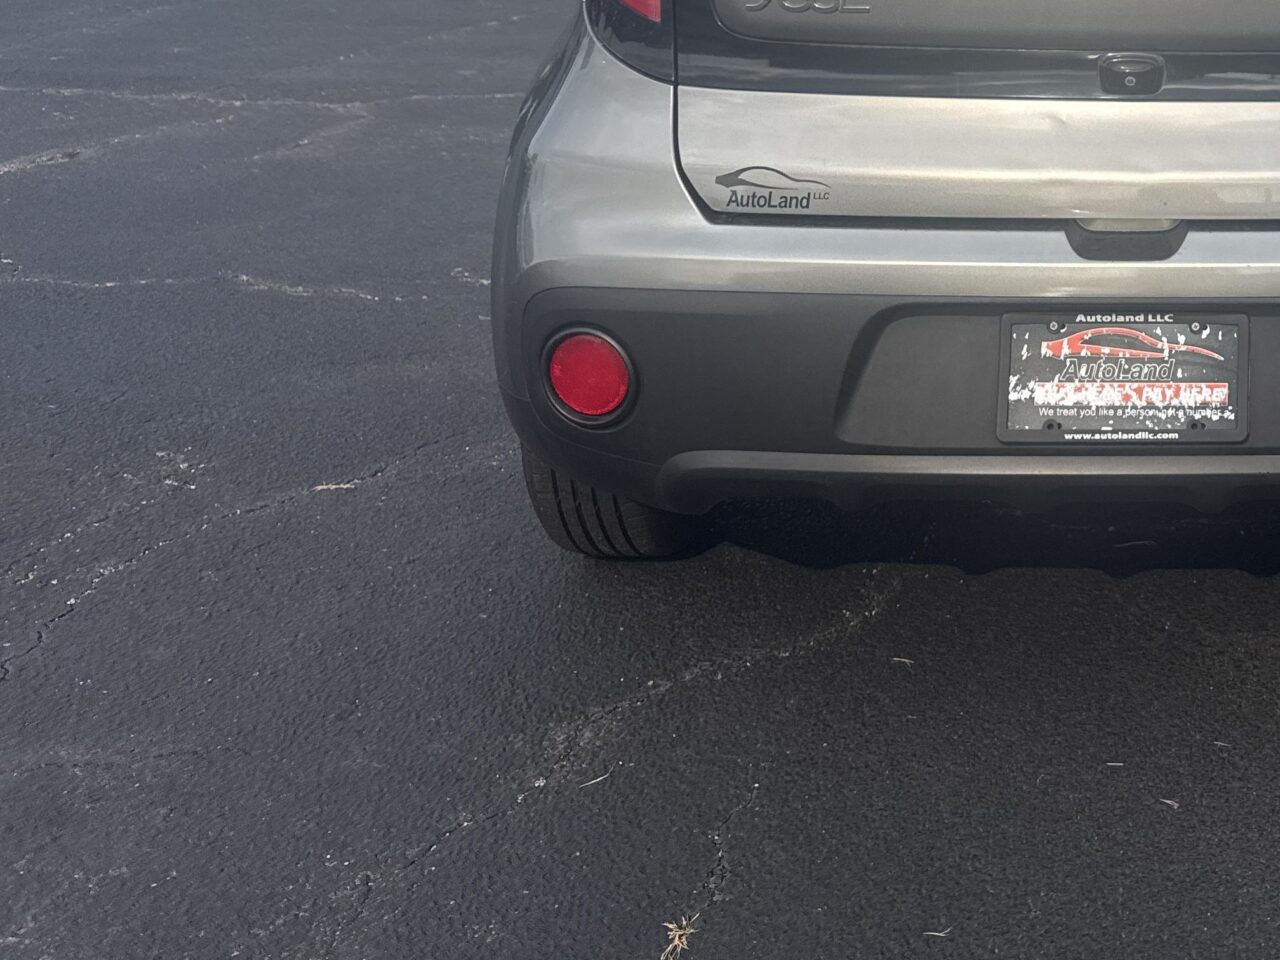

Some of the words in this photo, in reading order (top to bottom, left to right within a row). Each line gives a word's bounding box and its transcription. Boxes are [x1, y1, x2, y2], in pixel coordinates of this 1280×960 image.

[726, 190, 811, 209] AutoLand
[813, 192, 830, 200] LLC
[1076, 314, 1144, 323] Autoland
[1148, 314, 1174, 323] LLC
[1059, 358, 1175, 381] AutoLand
[1039, 407, 1054, 416] We
[1057, 407, 1077, 416] treat
[1080, 408, 1097, 419] you
[1099, 407, 1114, 416] like
[1064, 431, 1179, 440] www.autolandllc.com
